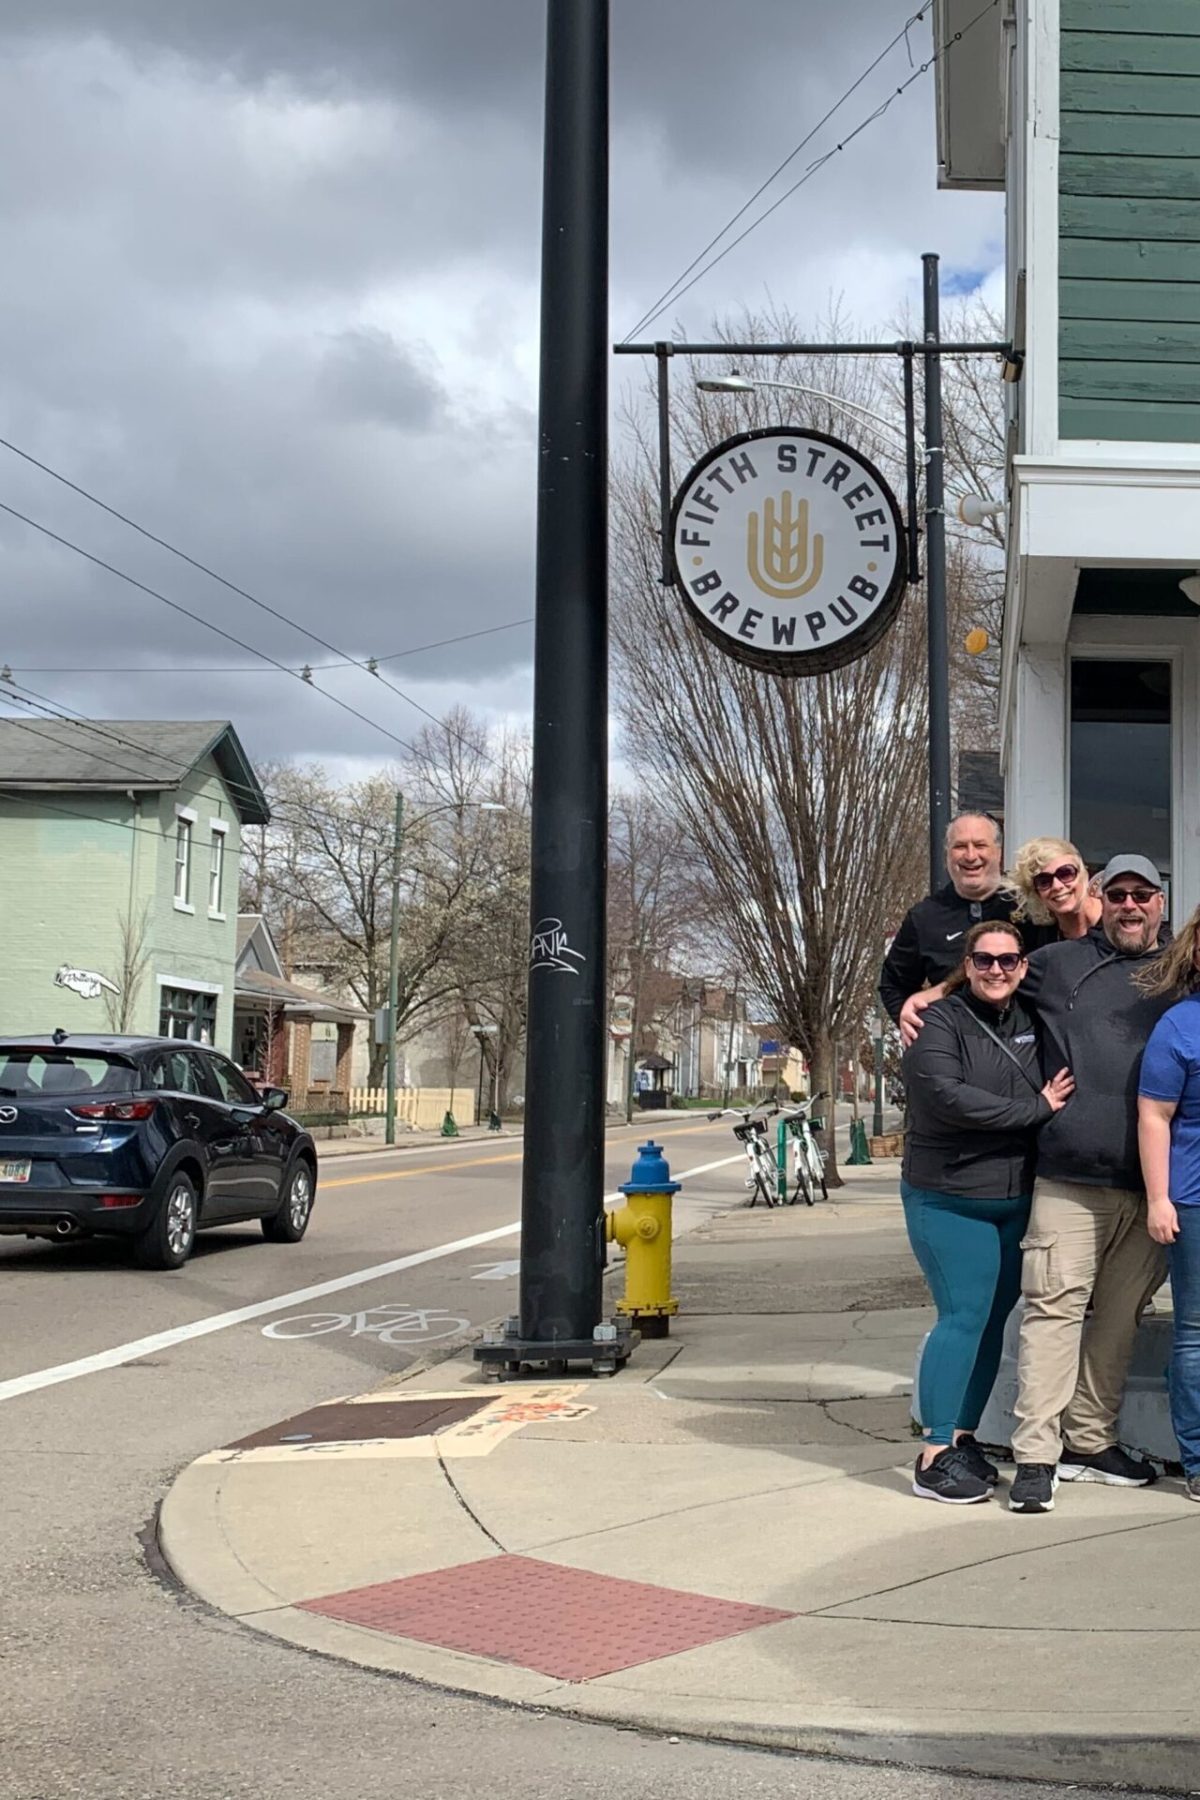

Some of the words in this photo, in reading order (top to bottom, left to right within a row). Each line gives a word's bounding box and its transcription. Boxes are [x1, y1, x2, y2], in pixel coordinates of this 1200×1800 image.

[680, 450, 759, 547] FIFTH
[776, 443, 890, 553] STREET
[689, 569, 880, 646] BREWPUB
